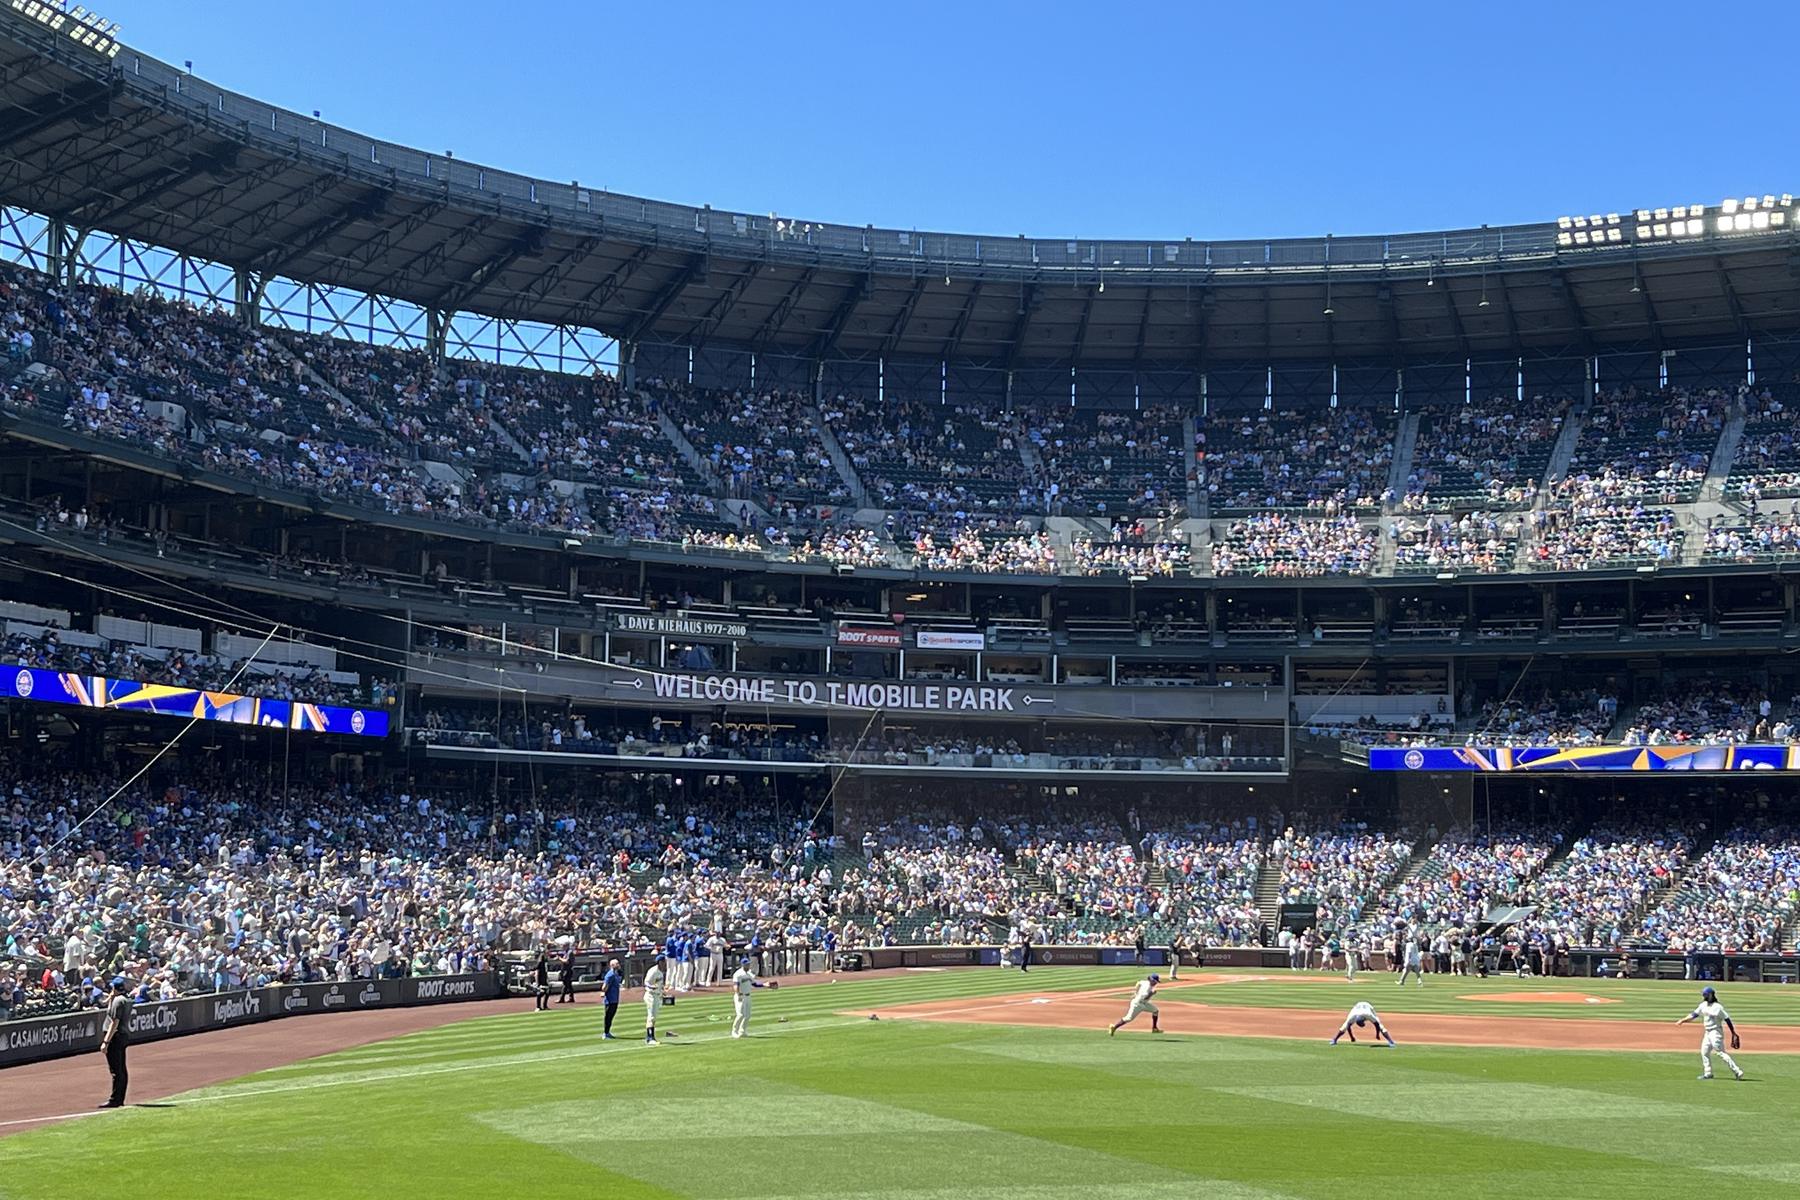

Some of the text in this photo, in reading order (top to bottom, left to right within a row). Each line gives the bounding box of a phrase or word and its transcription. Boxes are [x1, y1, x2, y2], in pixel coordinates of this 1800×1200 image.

[628, 616, 746, 636] DAVE NIEHAUS 1977-2010
[838, 631, 900, 644] ROOT SPORTS
[653, 673, 1014, 711] WELCOME TO T-MOBILE PARK
[417, 980, 475, 998] ROOT SPORTS
[128, 1005, 177, 1032] Great Clips
[214, 1000, 244, 1022] KeyBank
[11, 1022, 85, 1048] CASAMIGOS Tequila
